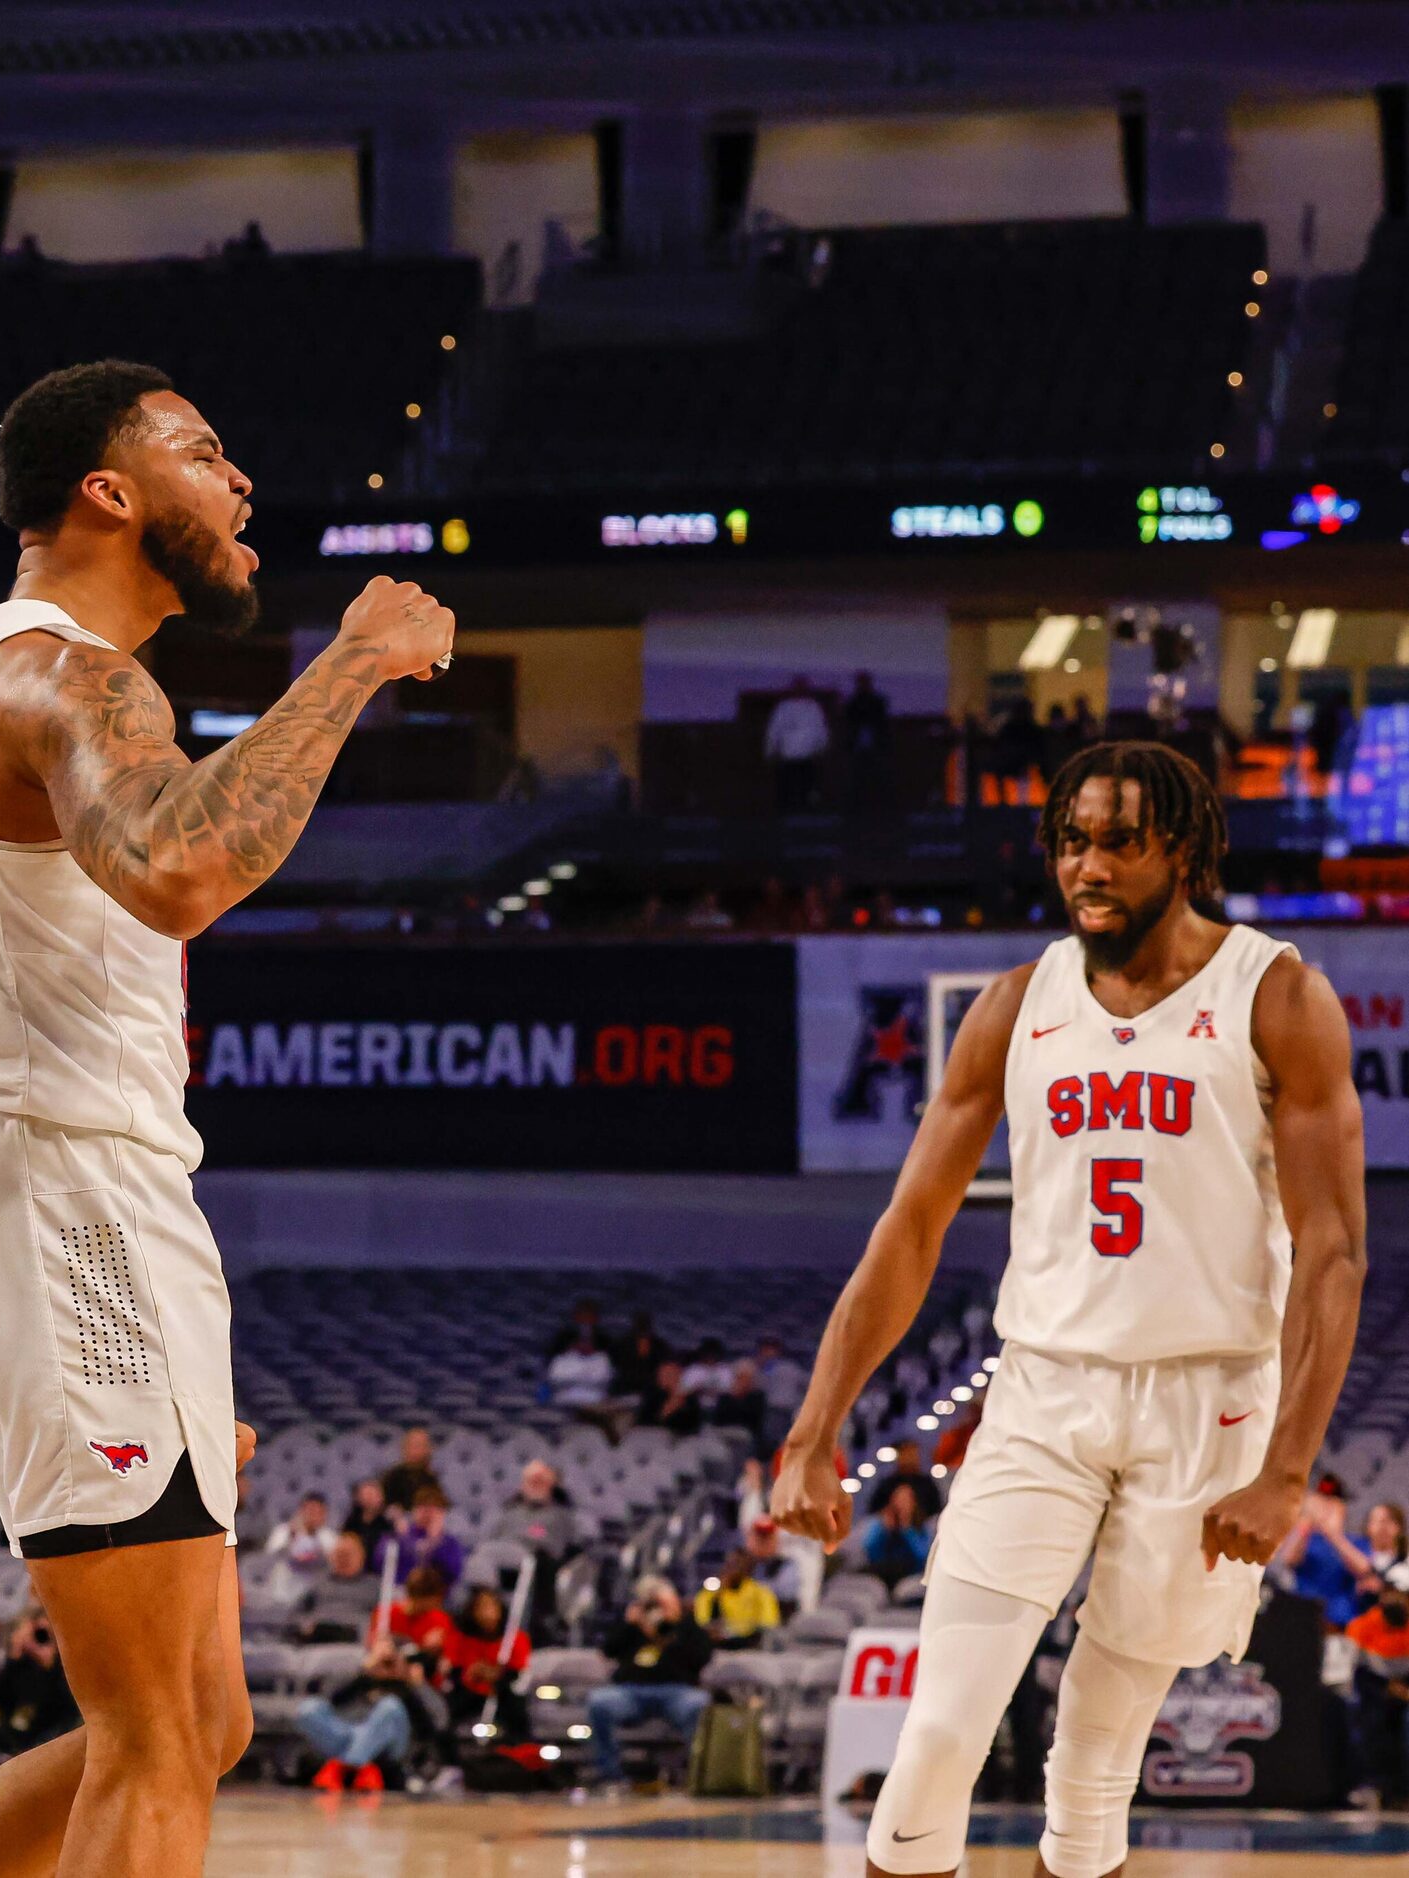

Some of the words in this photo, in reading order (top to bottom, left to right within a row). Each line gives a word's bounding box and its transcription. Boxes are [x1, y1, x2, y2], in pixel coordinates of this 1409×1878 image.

[601, 513, 717, 546] BLOCKS
[892, 503, 1004, 537] STEALS
[319, 523, 433, 555] ASSISTS
[1048, 1071, 1195, 1138] SMU
[1091, 1158, 1144, 1257] 5
